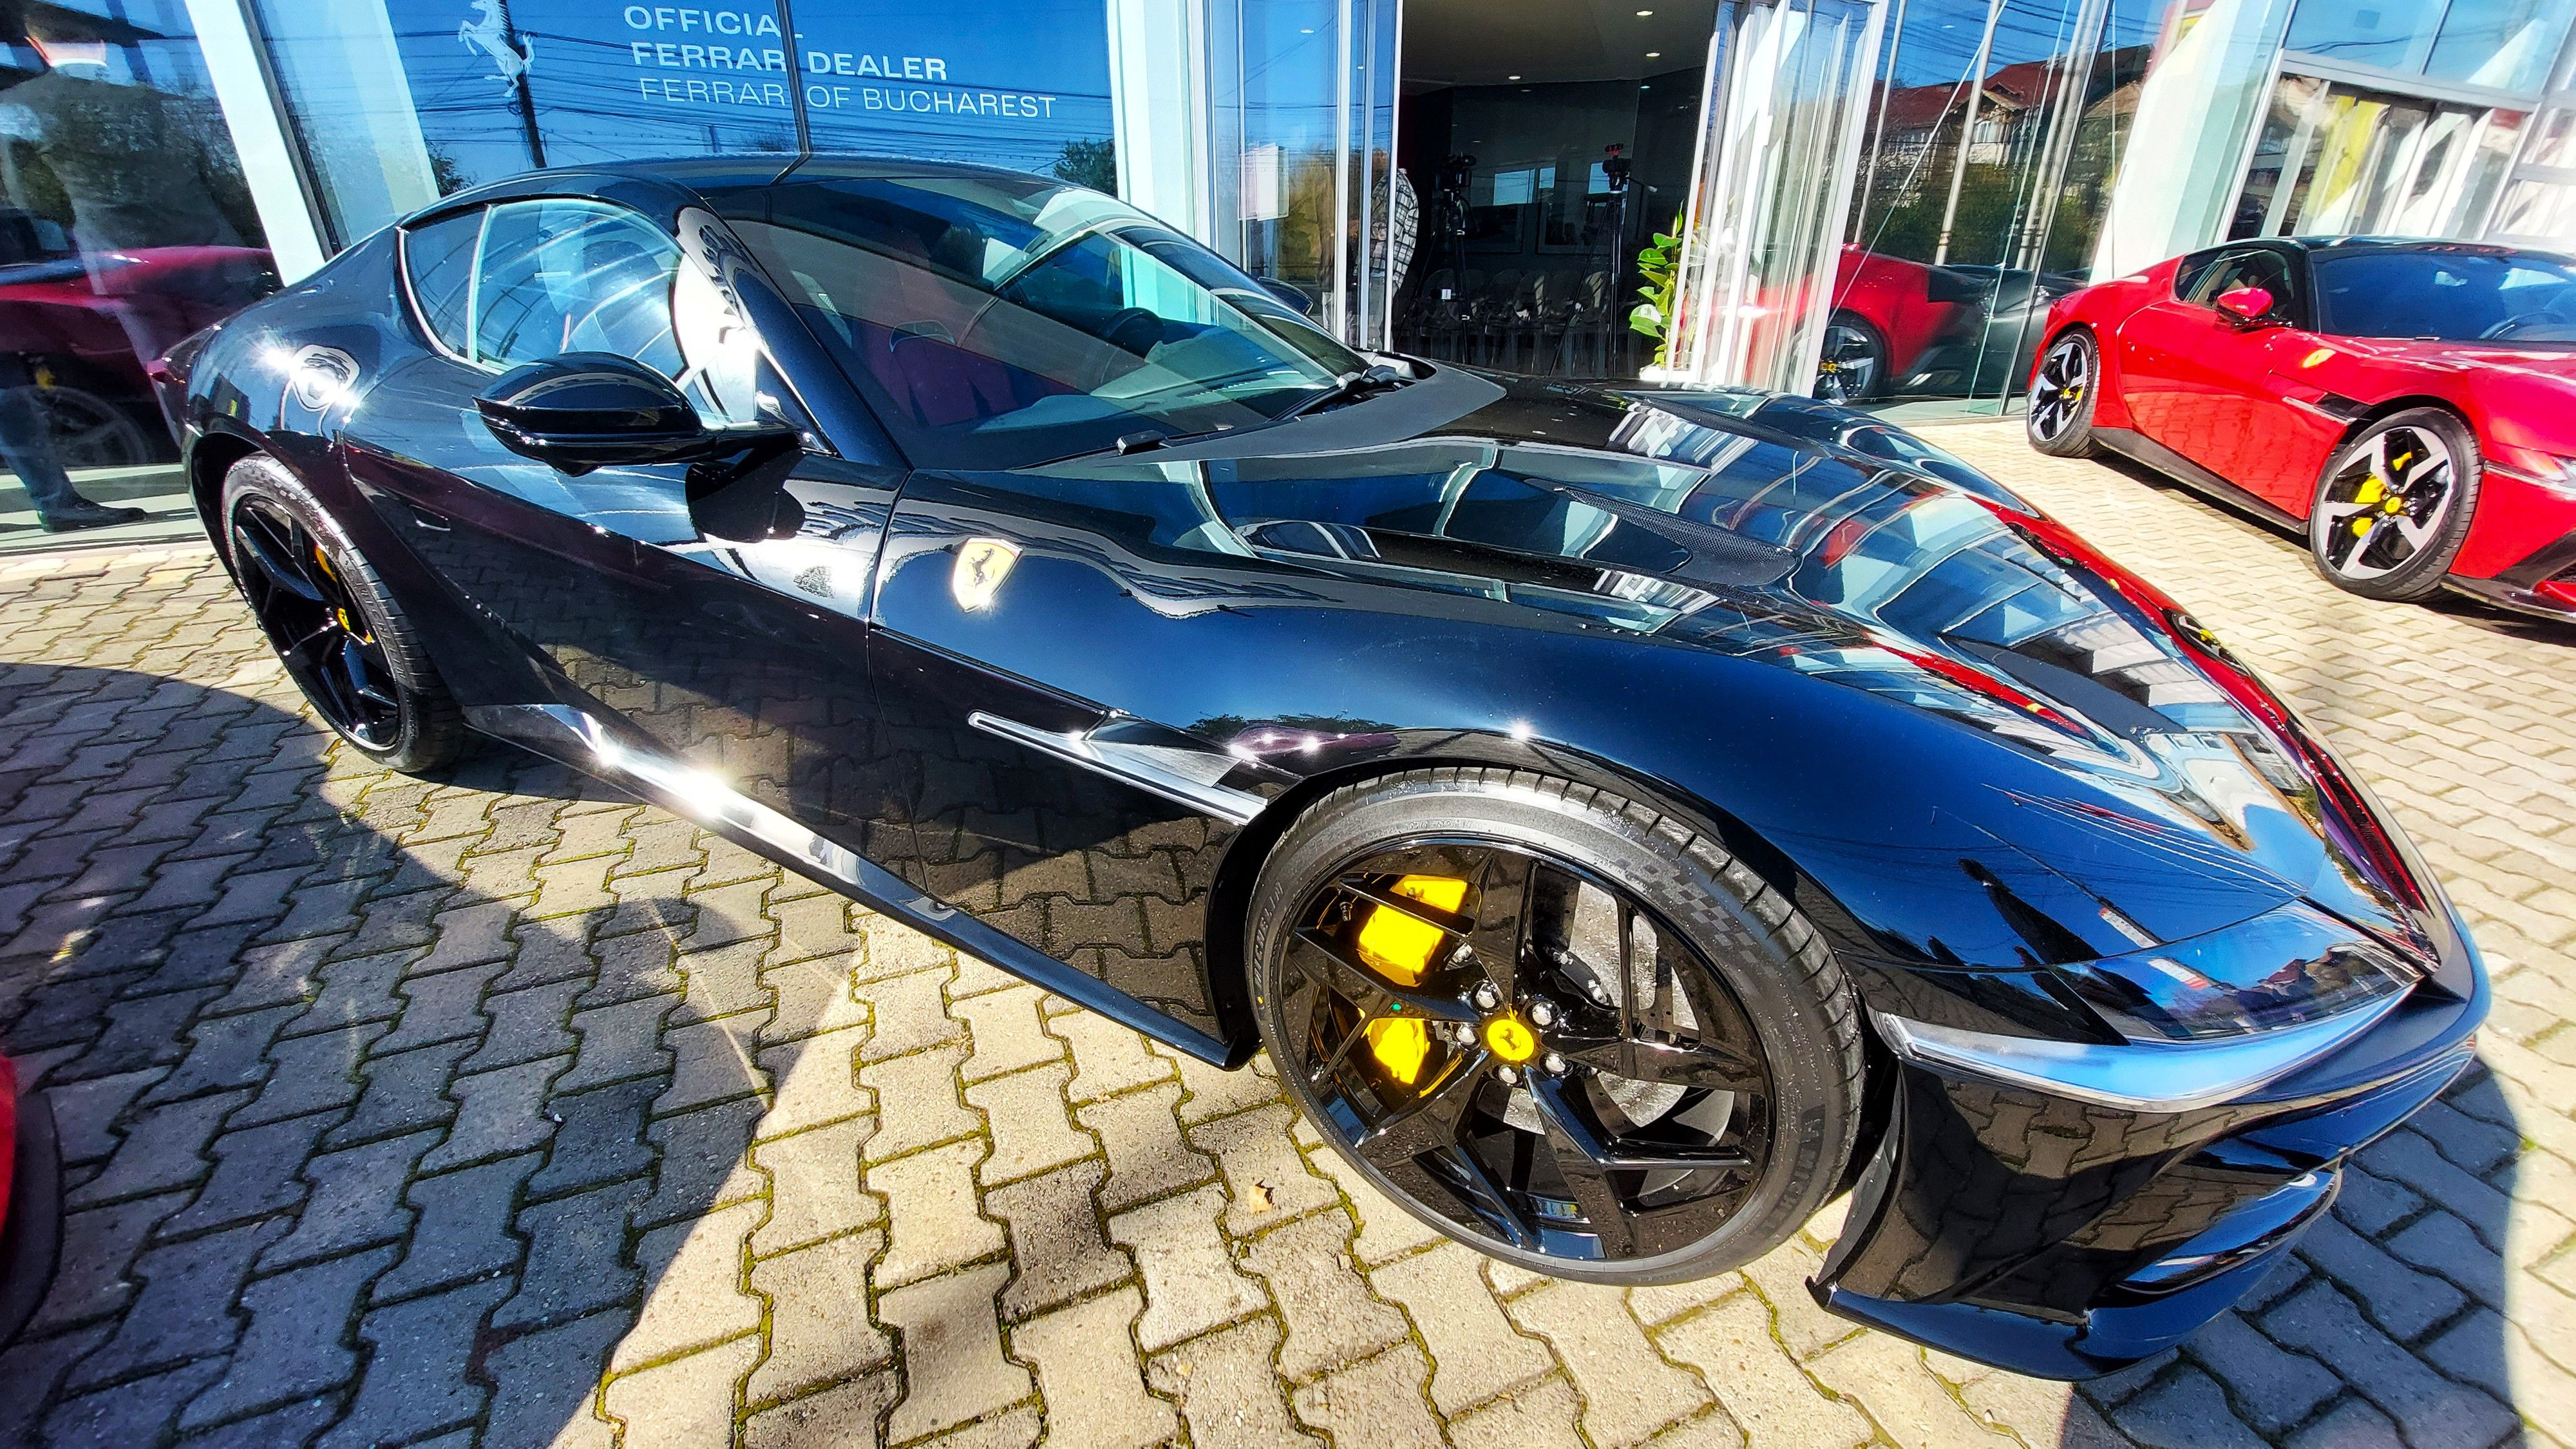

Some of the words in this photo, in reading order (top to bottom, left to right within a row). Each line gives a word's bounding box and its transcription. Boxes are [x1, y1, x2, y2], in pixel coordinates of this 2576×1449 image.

[624, 5, 804, 39] OFFICIA
[630, 41, 786, 72] FERRAR
[807, 51, 947, 80] DEALER
[639, 78, 786, 106] FERRAR
[806, 86, 851, 108] OF
[863, 88, 1057, 118] BUCHAREST
